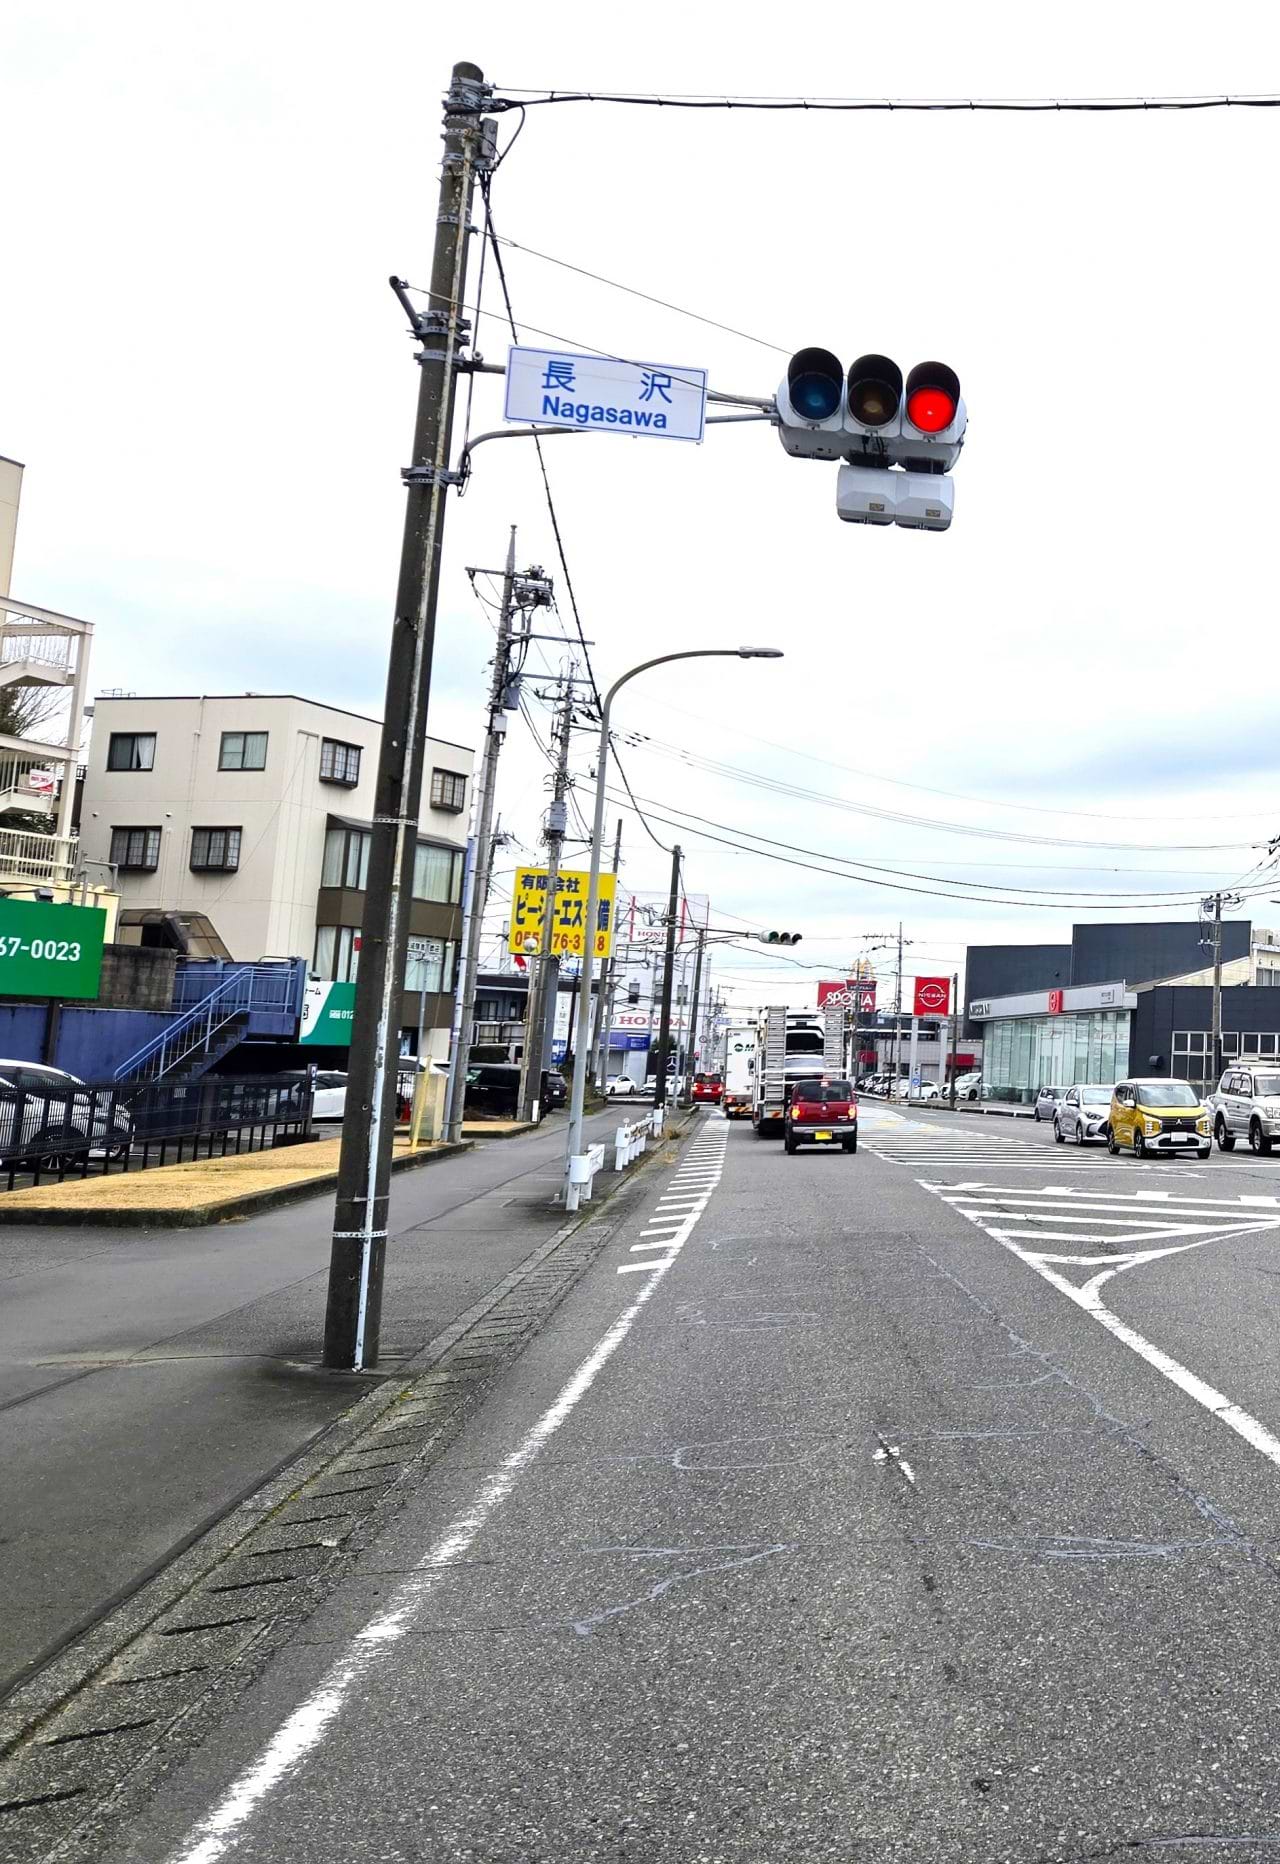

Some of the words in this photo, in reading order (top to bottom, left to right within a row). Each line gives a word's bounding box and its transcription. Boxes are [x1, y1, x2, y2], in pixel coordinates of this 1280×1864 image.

[542, 395, 668, 430] Nagasawa
[516, 893, 610, 931] ピーシーエス備
